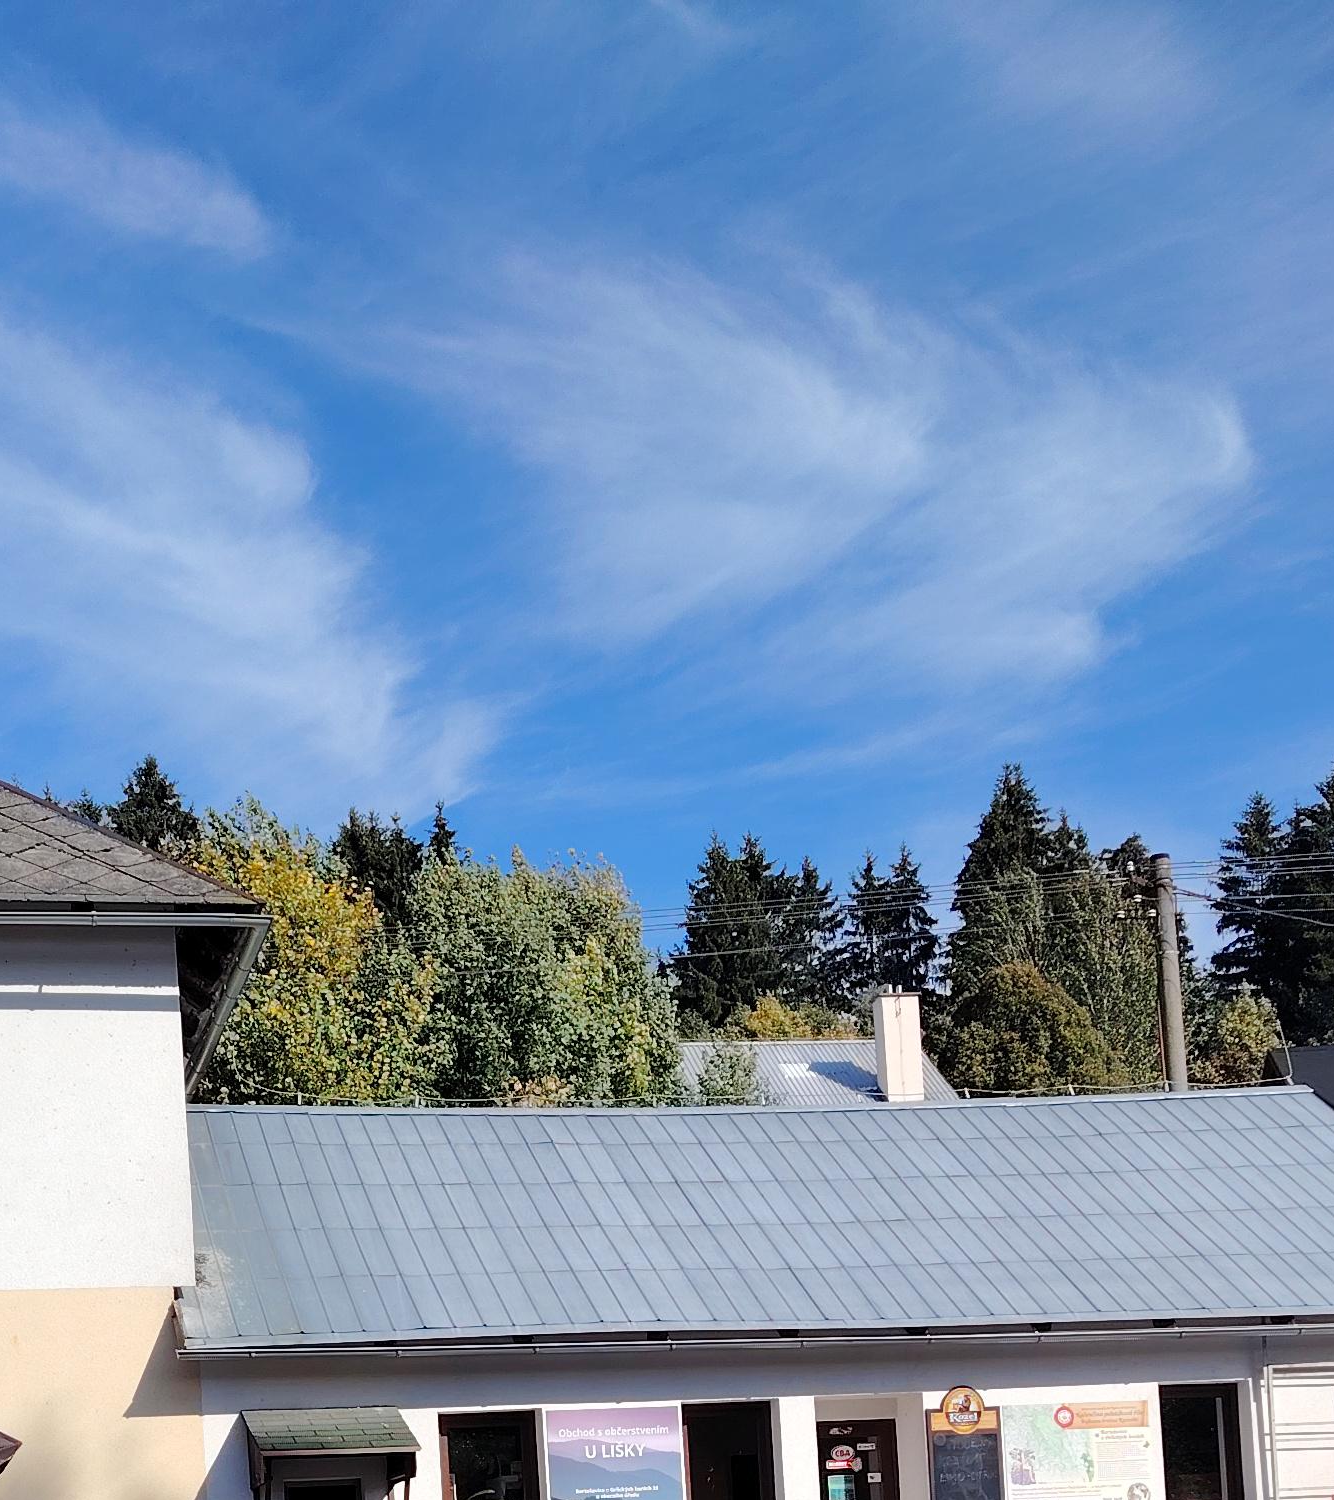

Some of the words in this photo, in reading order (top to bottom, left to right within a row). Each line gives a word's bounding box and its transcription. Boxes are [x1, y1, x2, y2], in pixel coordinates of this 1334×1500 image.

[948, 1412, 978, 1423] Kozel
[558, 1427, 596, 1438] Obchod
[597, 1429, 603, 1437] s
[604, 1424, 670, 1436] občerstvením
[585, 1445, 597, 1459] U
[601, 1440, 646, 1459] LIŠKY
